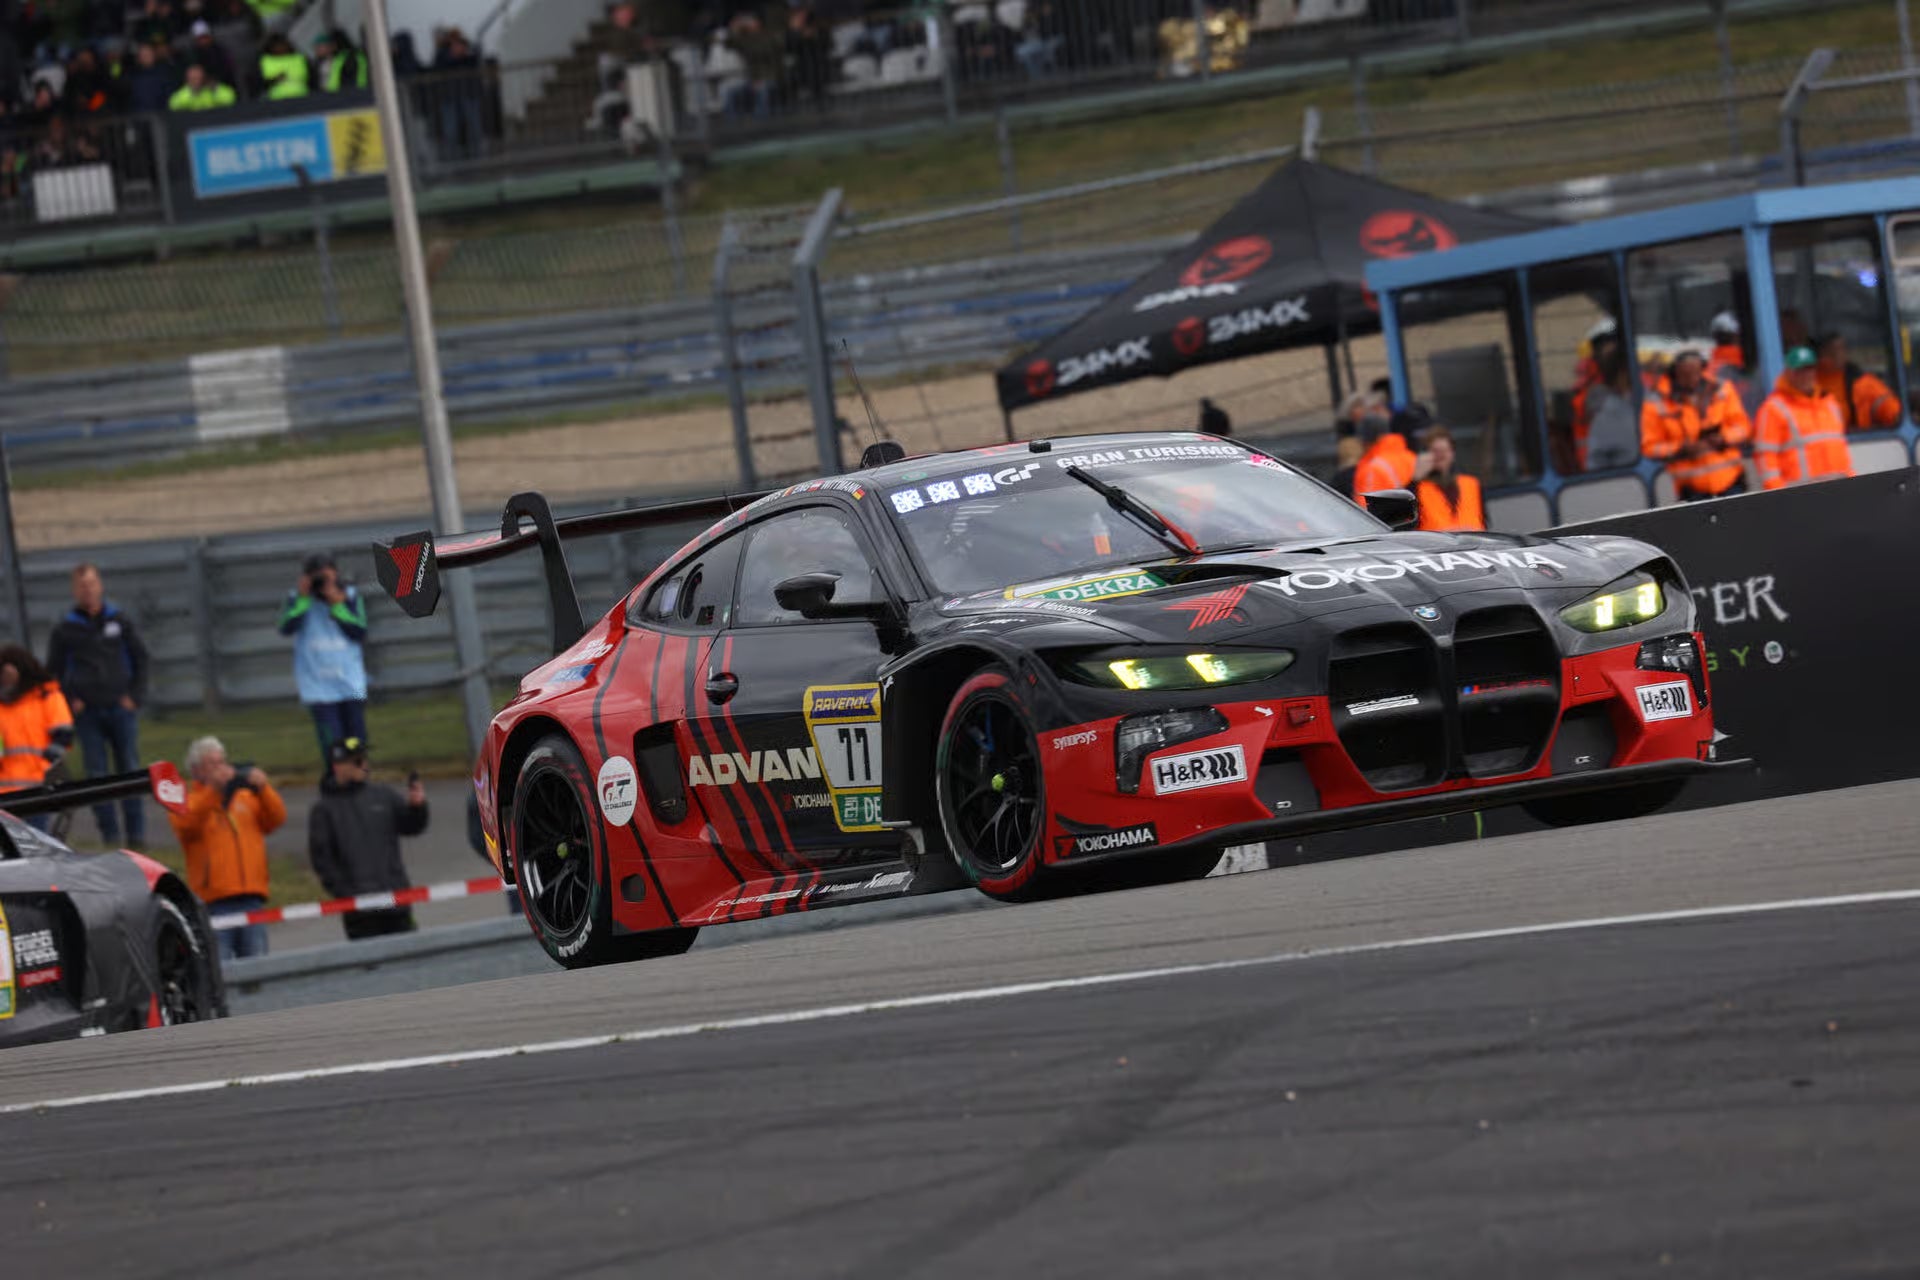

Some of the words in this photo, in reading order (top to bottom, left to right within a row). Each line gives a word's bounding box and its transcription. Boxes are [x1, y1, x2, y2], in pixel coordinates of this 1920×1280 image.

[207, 136, 319, 177] BILSTEIN
[1055, 451, 1126, 469] GRAN
[1128, 445, 1239, 460] TURISMO
[1058, 573, 1158, 601] DEKRA
[1263, 550, 1567, 597] YOKOHAMA
[814, 695, 869, 712] RAVENOL
[1641, 689, 1672, 714] H&R
[689, 747, 822, 787] ADVAN
[838, 728, 871, 781] 77
[1158, 759, 1207, 786] H&R
[792, 793, 833, 809] YOKOHAMA
[1076, 828, 1154, 852] YOKOHAMA
[558, 914, 593, 957] ADVAN
